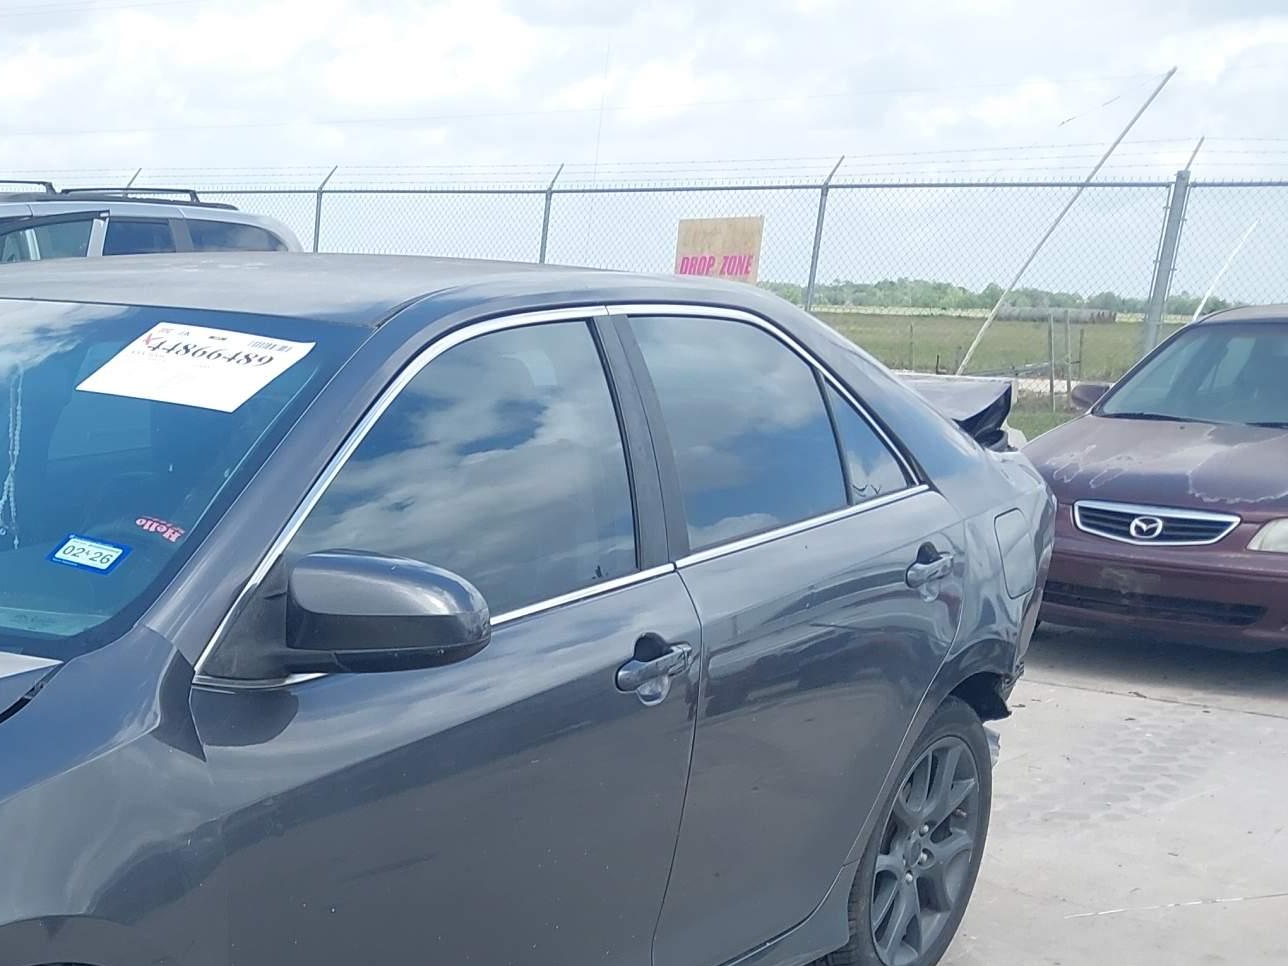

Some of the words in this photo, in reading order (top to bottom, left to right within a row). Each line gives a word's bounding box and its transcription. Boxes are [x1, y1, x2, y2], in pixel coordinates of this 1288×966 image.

[679, 255, 716, 276] DROP
[719, 254, 754, 276] ZONE
[147, 338, 274, 367] 44866489
[135, 518, 182, 542] Hello
